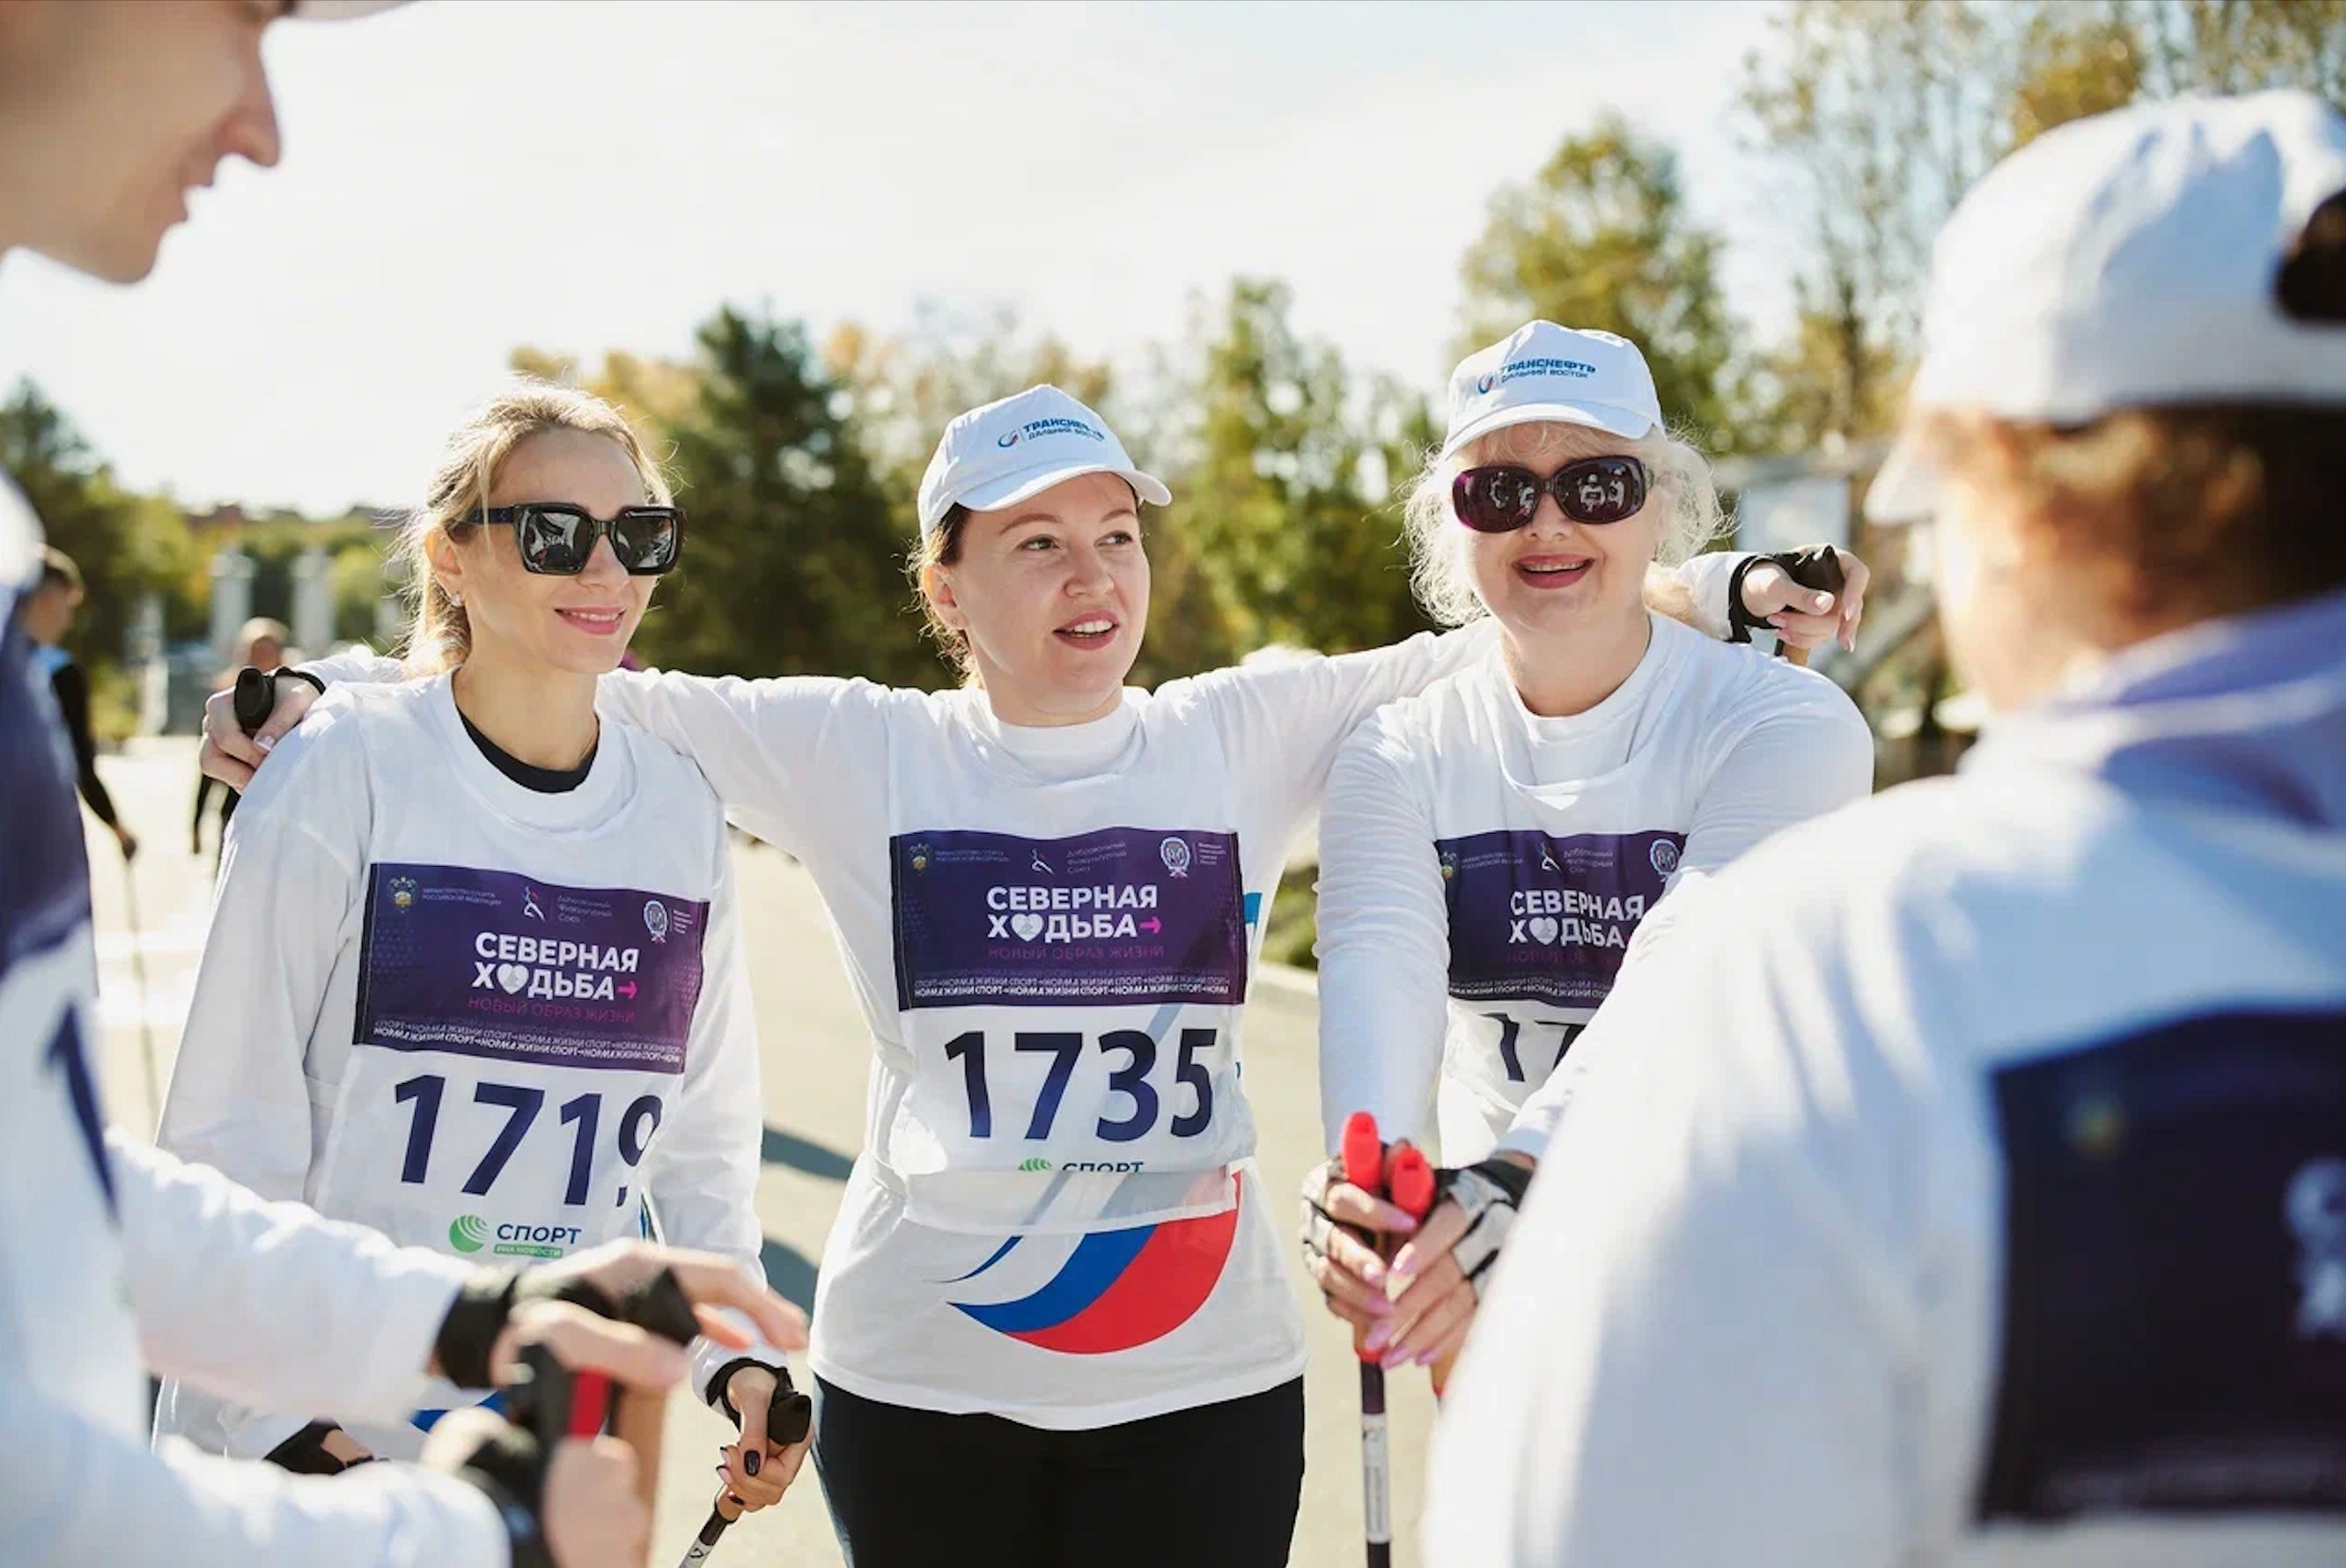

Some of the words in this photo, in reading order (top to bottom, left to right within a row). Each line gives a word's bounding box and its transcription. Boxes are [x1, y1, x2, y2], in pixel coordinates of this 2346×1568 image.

[1501, 358, 1596, 374] ТРАНСНЕФТЬ
[1550, 369, 1588, 379] ВОСТОК
[987, 884, 1158, 911] СЕВЕРНАЯ
[1510, 890, 1646, 921] СЕВЕРНАЯ
[475, 932, 640, 973] СЕВЕРНАЯ
[468, 997, 527, 1014] НОВЫЙ
[532, 1003, 581, 1019] ОБРАЗ
[585, 1009, 636, 1024] ЖИЗНИ
[944, 1028, 1217, 1142] 1735
[395, 1074, 663, 1208] 1719
[497, 1223, 582, 1245] СПОРТ
